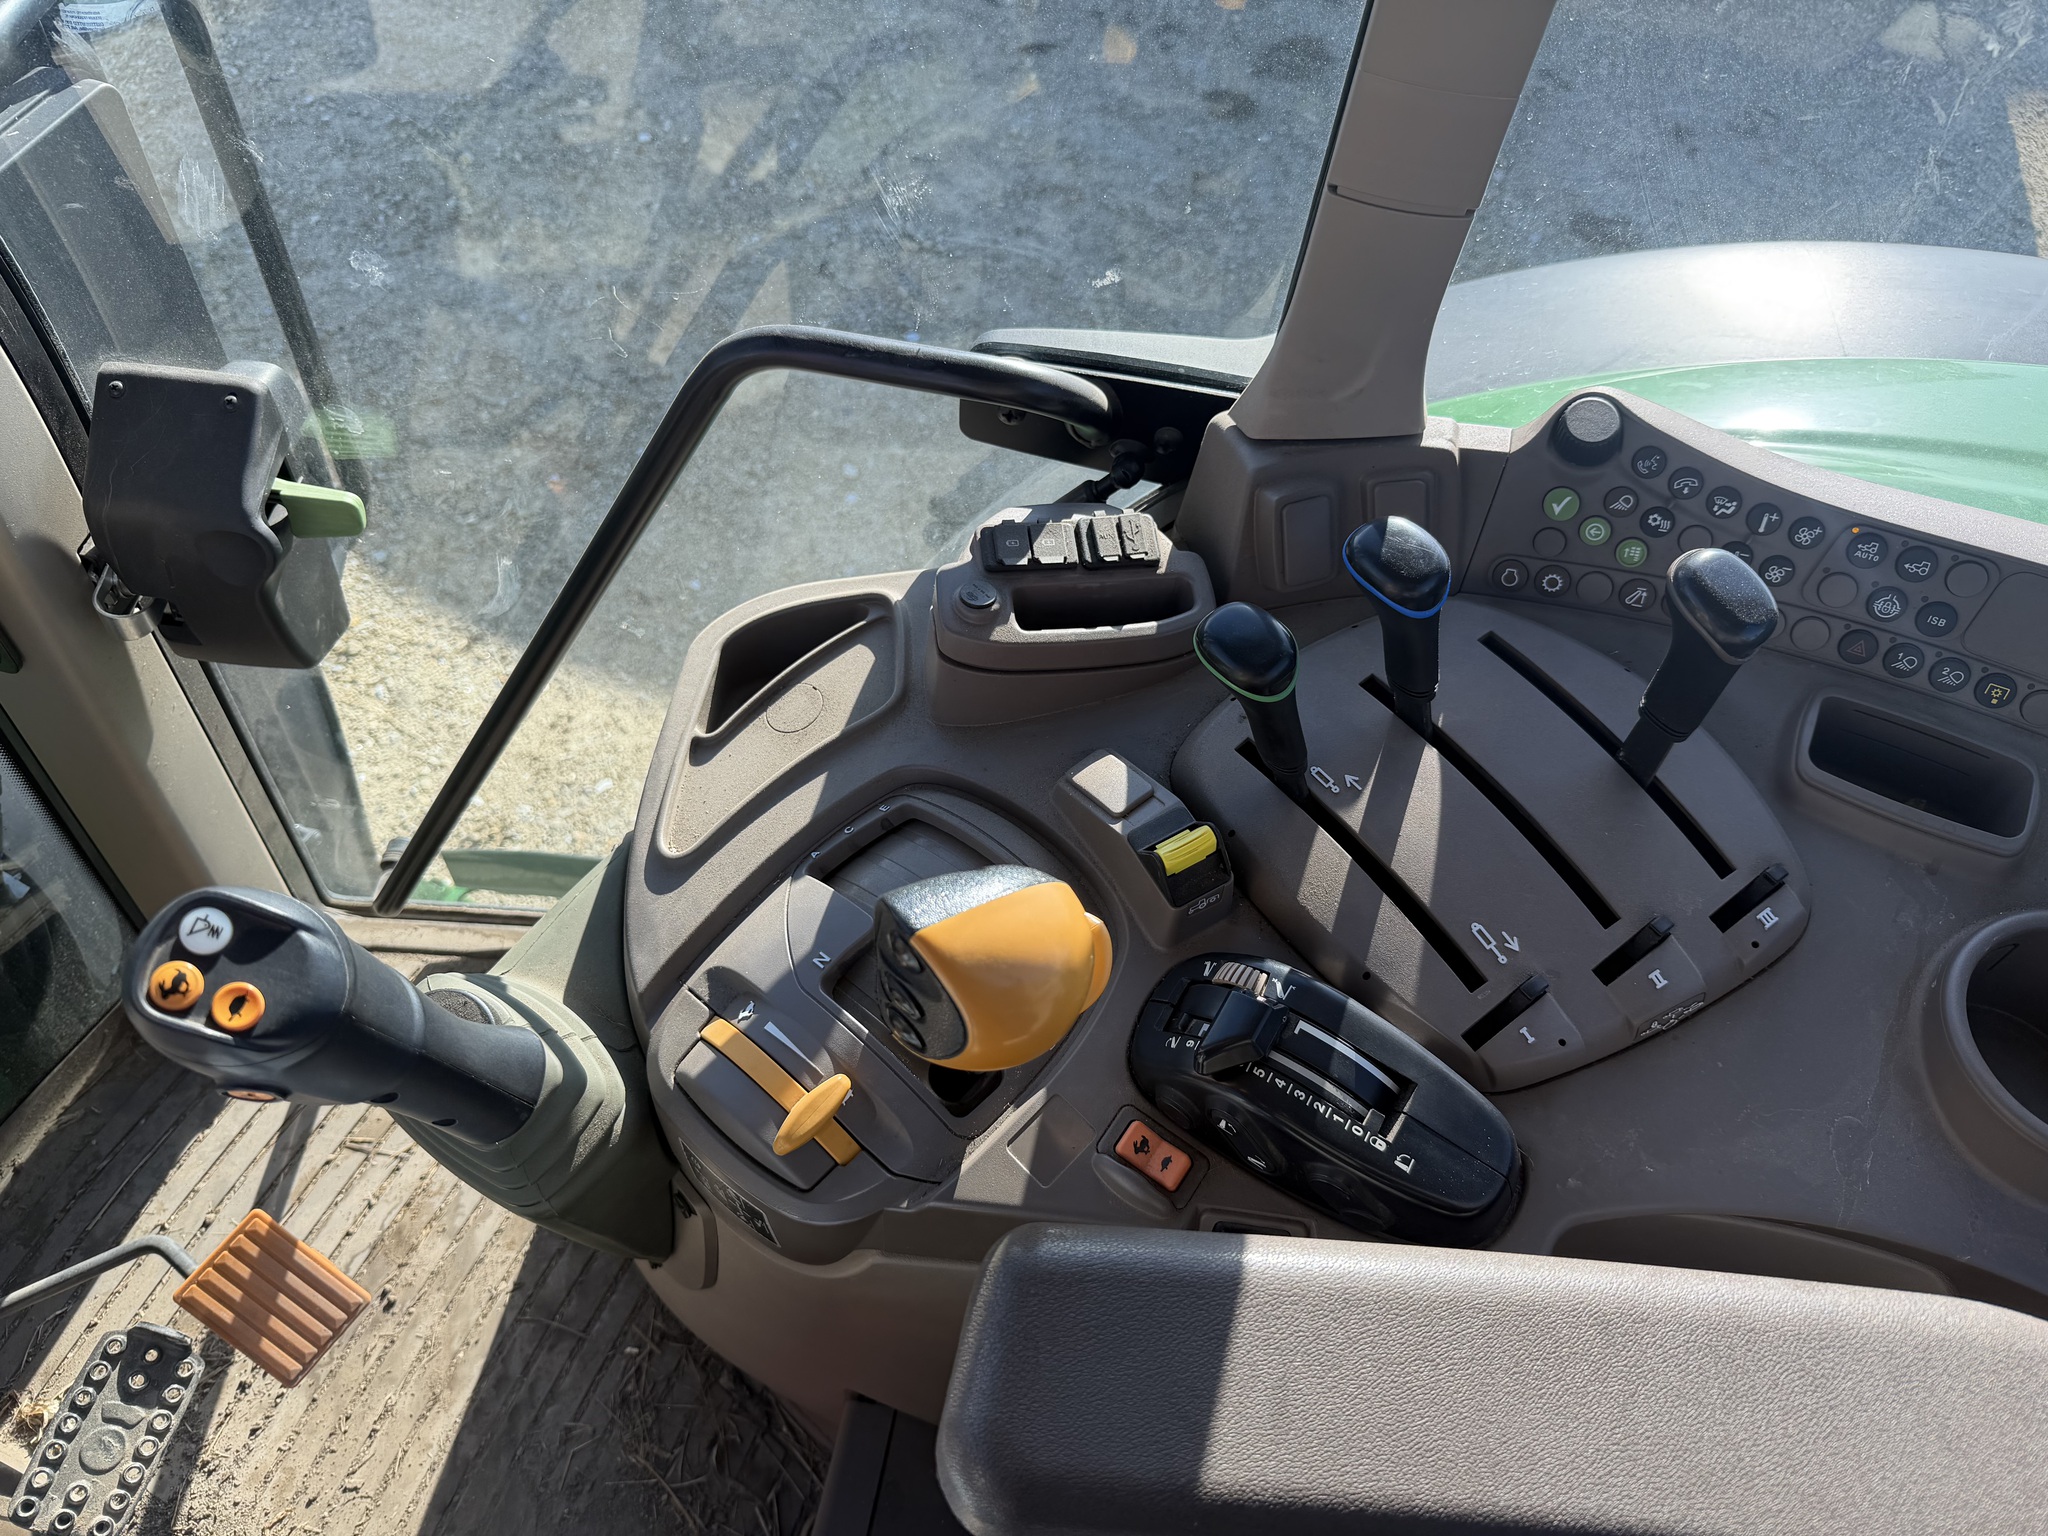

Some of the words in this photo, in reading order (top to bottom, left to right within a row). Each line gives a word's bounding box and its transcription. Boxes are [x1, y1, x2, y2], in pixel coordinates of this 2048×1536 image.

[1853, 550, 1880, 562] AUTO
[1926, 615, 1947, 627] ISB
[1897, 652, 1904, 660] 1
[1941, 667, 1950, 676] 2
[878, 804, 890, 812] E
[844, 826, 854, 834] C
[810, 851, 821, 859] A
[812, 951, 831, 969] N
[1252, 1066, 1265, 1078] 5
[1274, 1077, 1287, 1089] 4
[1293, 1089, 1306, 1101] 3
[1313, 1101, 1326, 1114] 2
[1332, 1113, 1345, 1124] 1
[1351, 1125, 1364, 1136] 0
